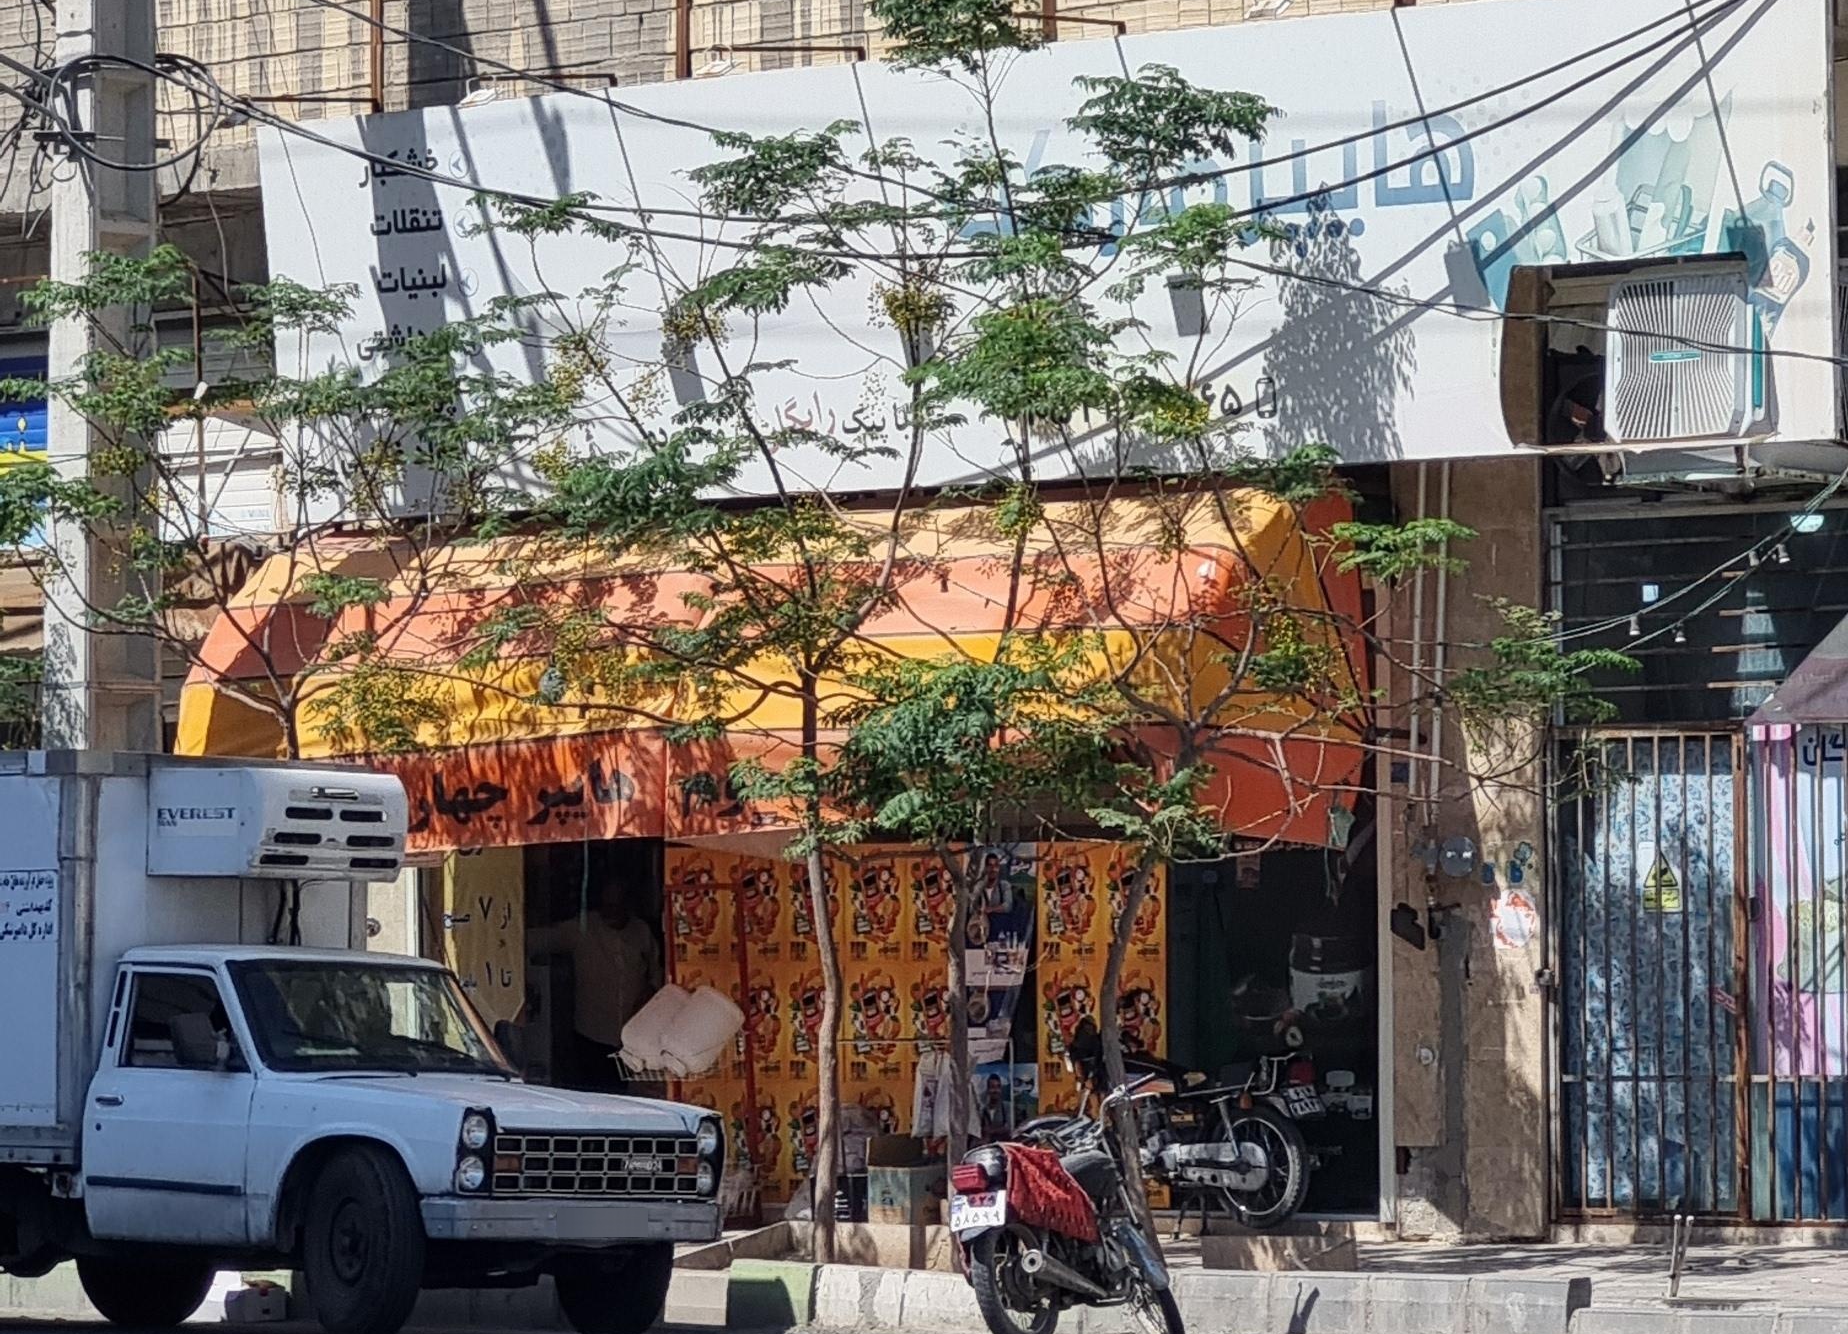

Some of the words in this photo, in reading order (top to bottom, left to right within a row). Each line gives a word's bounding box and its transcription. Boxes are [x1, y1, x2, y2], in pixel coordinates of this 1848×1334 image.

[358, 147, 439, 189] خشکبار
[369, 207, 443, 237] تنقلات
[376, 264, 448, 300] لبنیات
[156, 806, 237, 820] EVEREST
